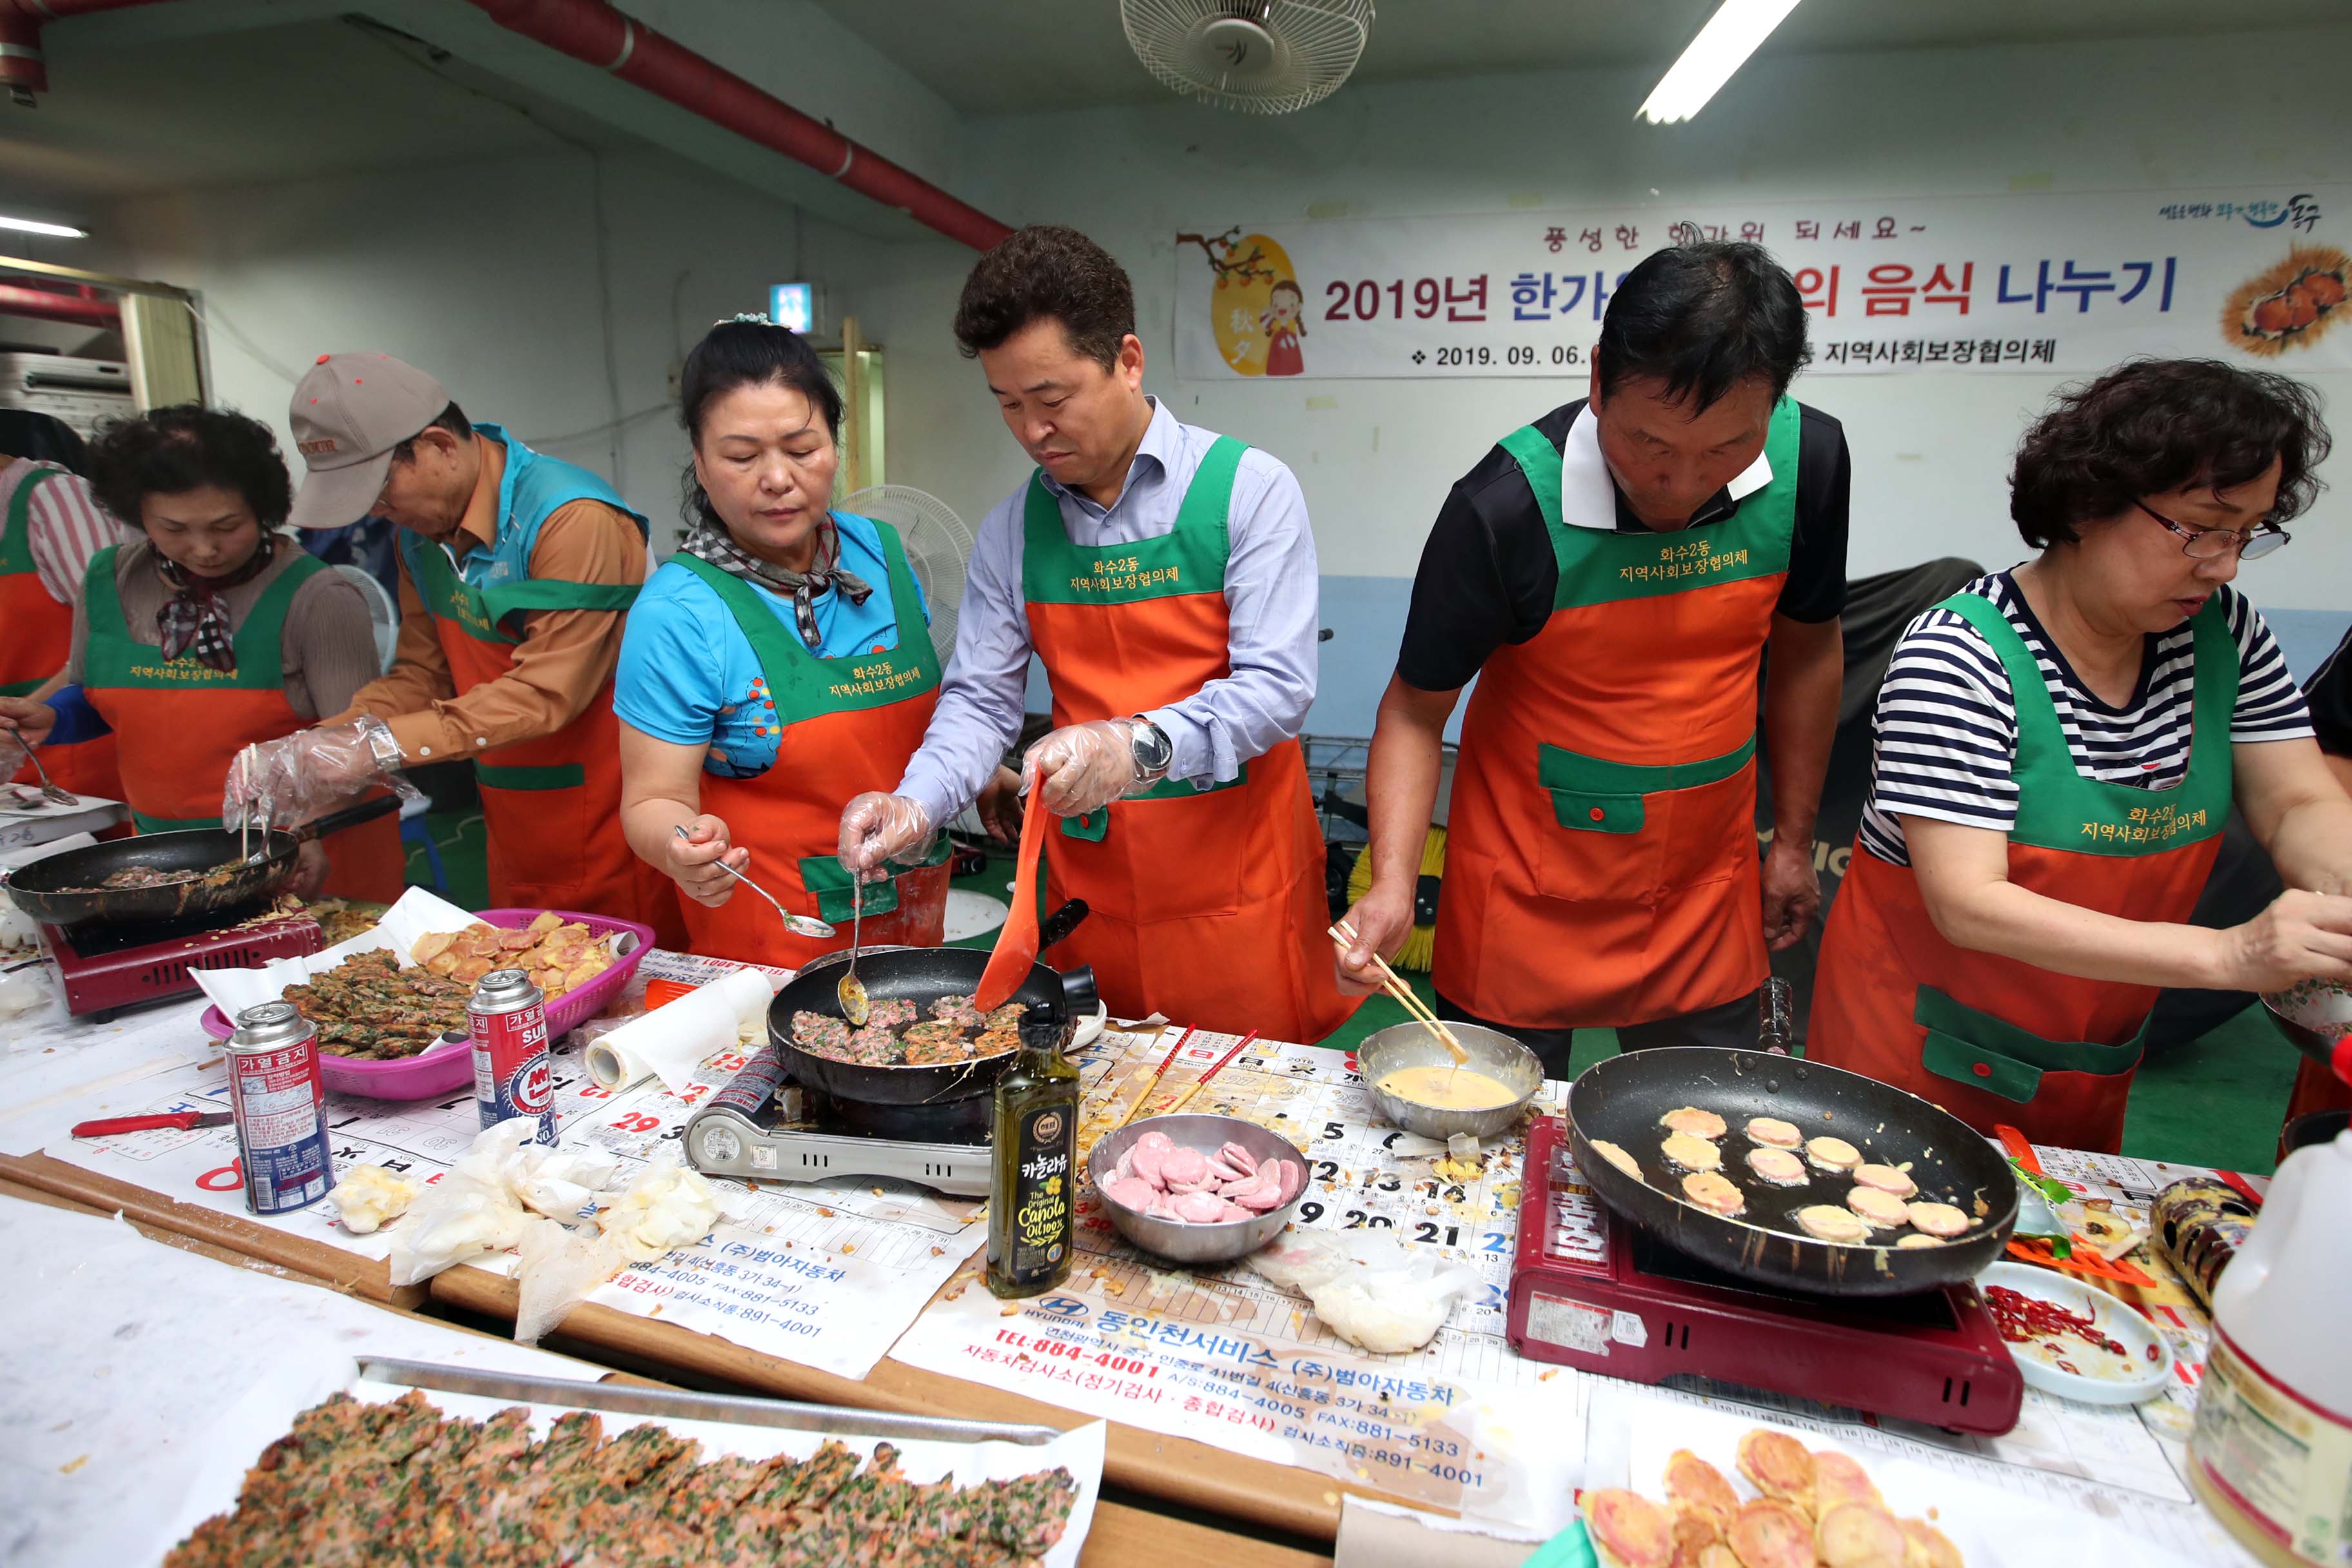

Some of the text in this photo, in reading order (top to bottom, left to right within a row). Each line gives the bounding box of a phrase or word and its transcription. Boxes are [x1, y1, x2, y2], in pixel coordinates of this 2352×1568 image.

[1544, 224, 1641, 253] 풍성한
[1324, 274, 1489, 322] 2019년
[1510, 270, 1626, 322] 한가
[1862, 261, 1974, 316] 음식
[1997, 256, 2177, 315] 나누기
[1230, 308, 1255, 365] 秋夕
[1436, 345, 1586, 367] 2019. 09. 06.
[1826, 339, 2057, 364] 지역사회보장협의체
[1660, 540, 1711, 563] 화수2동
[1093, 556, 1140, 575] 화수2동
[1619, 549, 1749, 582] 지역사회보장협의체
[1070, 566, 1179, 592] 지역사회보장협의체
[828, 668, 921, 698] 지역사회보장협의체
[852, 662, 893, 680] 화수2동
[241, 1046, 306, 1070] 가열금지
[607, 1112, 660, 1133] 29
[1322, 1122, 1345, 1140] 5
[1021, 1153, 1068, 1180] 카놀라유
[1028, 1195, 1055, 1210] Original
[1030, 1191, 1044, 1200] The
[1017, 1195, 1066, 1227] Canola
[1300, 1201, 1325, 1224] 9
[1414, 1221, 1460, 1246] 21
[1482, 1232, 1514, 1253] 2
[720, 1240, 847, 1283] (주)범아자동차
[712, 1282, 819, 1316] FAX:881-5133
[1023, 1308, 1086, 1329] HYUNDAI
[1096, 1309, 1455, 1407] 동인천서비스 (주)범아자동차
[1209, 1367, 1262, 1389] 41번길
[995, 1328, 1460, 1458] TEL:884-4001 A/S:884-4005 FAX:881-5133
[1182, 1394, 1277, 1433] 종합검사)
